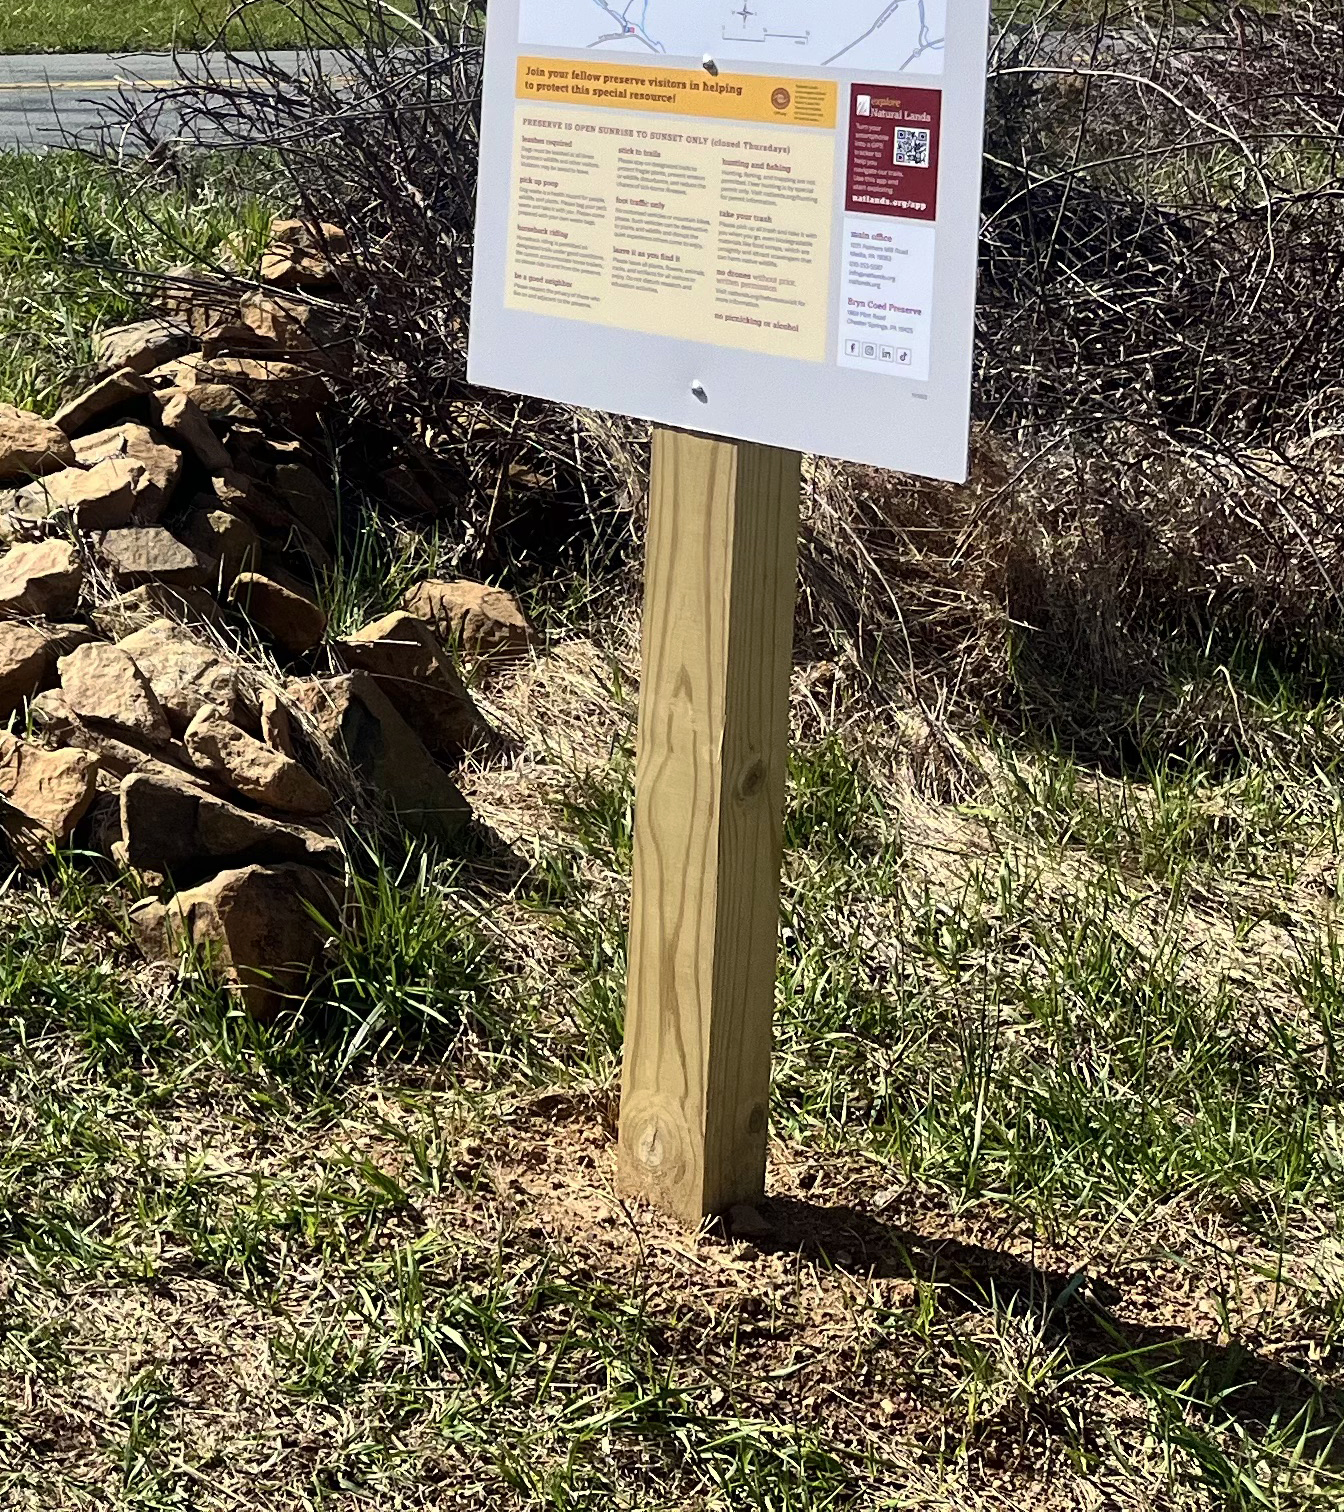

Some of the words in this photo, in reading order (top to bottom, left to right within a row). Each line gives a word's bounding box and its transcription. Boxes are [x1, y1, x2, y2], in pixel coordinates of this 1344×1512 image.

[525, 66, 546, 77] Join
[548, 70, 569, 80] your
[571, 70, 602, 82] fellow
[603, 75, 646, 86] preserve
[648, 77, 687, 90] visitors
[689, 80, 700, 91] in
[702, 81, 743, 96] helping
[525, 81, 534, 90] to
[536, 83, 569, 93] protect
[571, 84, 590, 95] this
[592, 88, 627, 99] special
[630, 92, 677, 104] resource!
[870, 108, 903, 120] Natural
[904, 110, 931, 122] Lands
[523, 118, 563, 130] PRESERVE
[564, 123, 573, 131] IS
[574, 124, 596, 133] OPEN
[598, 126, 634, 138] SUNRISE
[636, 130, 648, 139] TO
[650, 132, 684, 143] SUNSET
[685, 135, 709, 145] ONLY
[711, 138, 741, 149] (closed
[743, 141, 791, 155] Thursdays)
[852, 195, 927, 211] natlands.org/app
[847, 297, 866, 308] Bryn
[867, 300, 887, 311] Coed
[889, 303, 922, 316] Preserve
